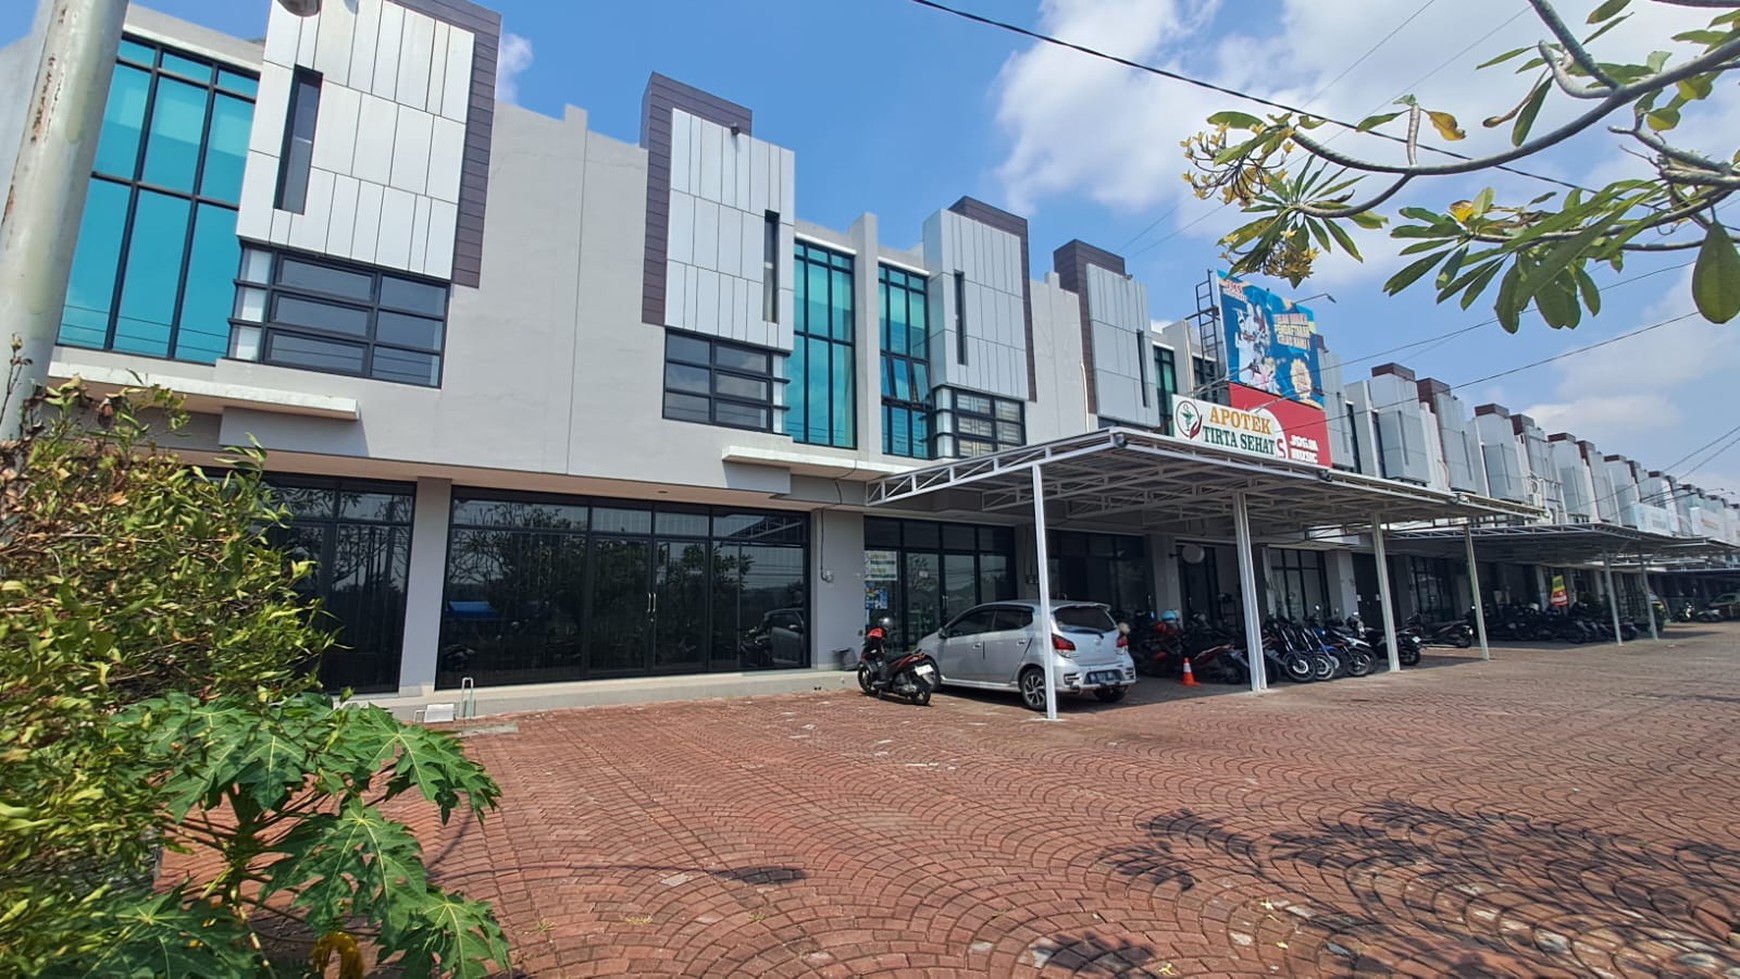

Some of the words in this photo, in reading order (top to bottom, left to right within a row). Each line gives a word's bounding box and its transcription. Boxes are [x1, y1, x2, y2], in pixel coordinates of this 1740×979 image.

[1209, 406, 1272, 435] APOTEK
[1202, 425, 1239, 449] TIRTA
[1239, 433, 1276, 456] SEHAT
